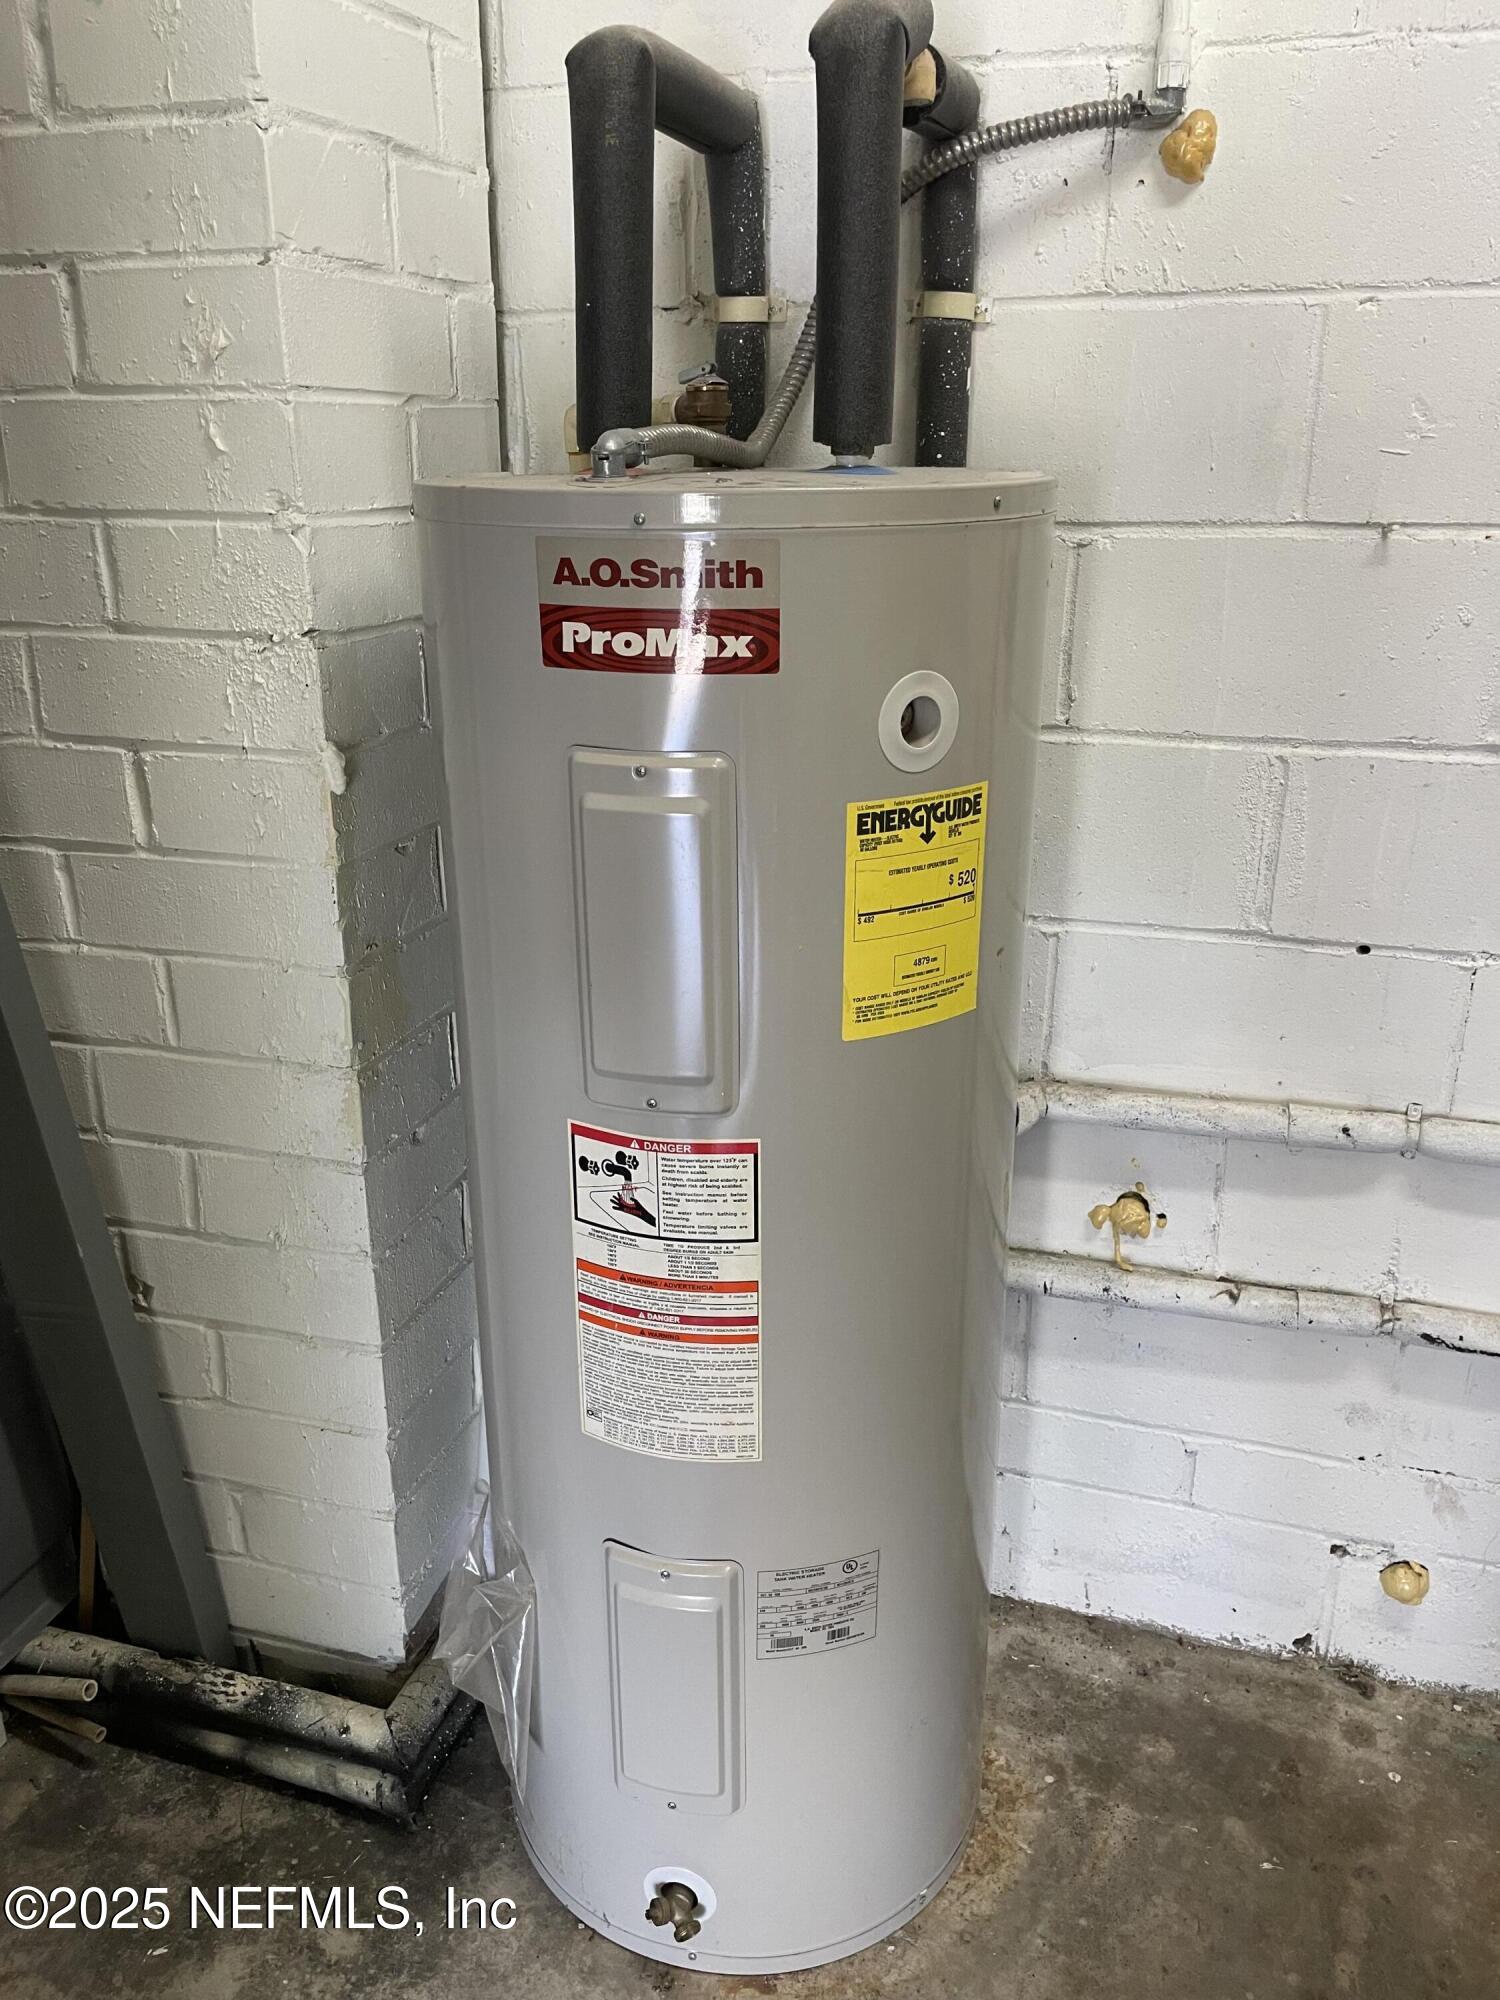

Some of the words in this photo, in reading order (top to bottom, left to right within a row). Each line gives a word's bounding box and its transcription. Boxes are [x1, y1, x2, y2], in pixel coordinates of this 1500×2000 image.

[856, 793, 983, 838] ENERGYGUIDE
[949, 873, 954, 885] $
[958, 868, 977, 887] 520
[913, 956, 930, 966] 4879
[643, 1142, 691, 1153] DANGER
[627, 1276, 658, 1287] WARNING
[663, 1282, 713, 1291] ADVERTENCIA
[647, 1312, 680, 1323] DANGER
[648, 1331, 680, 1341] WARNING
